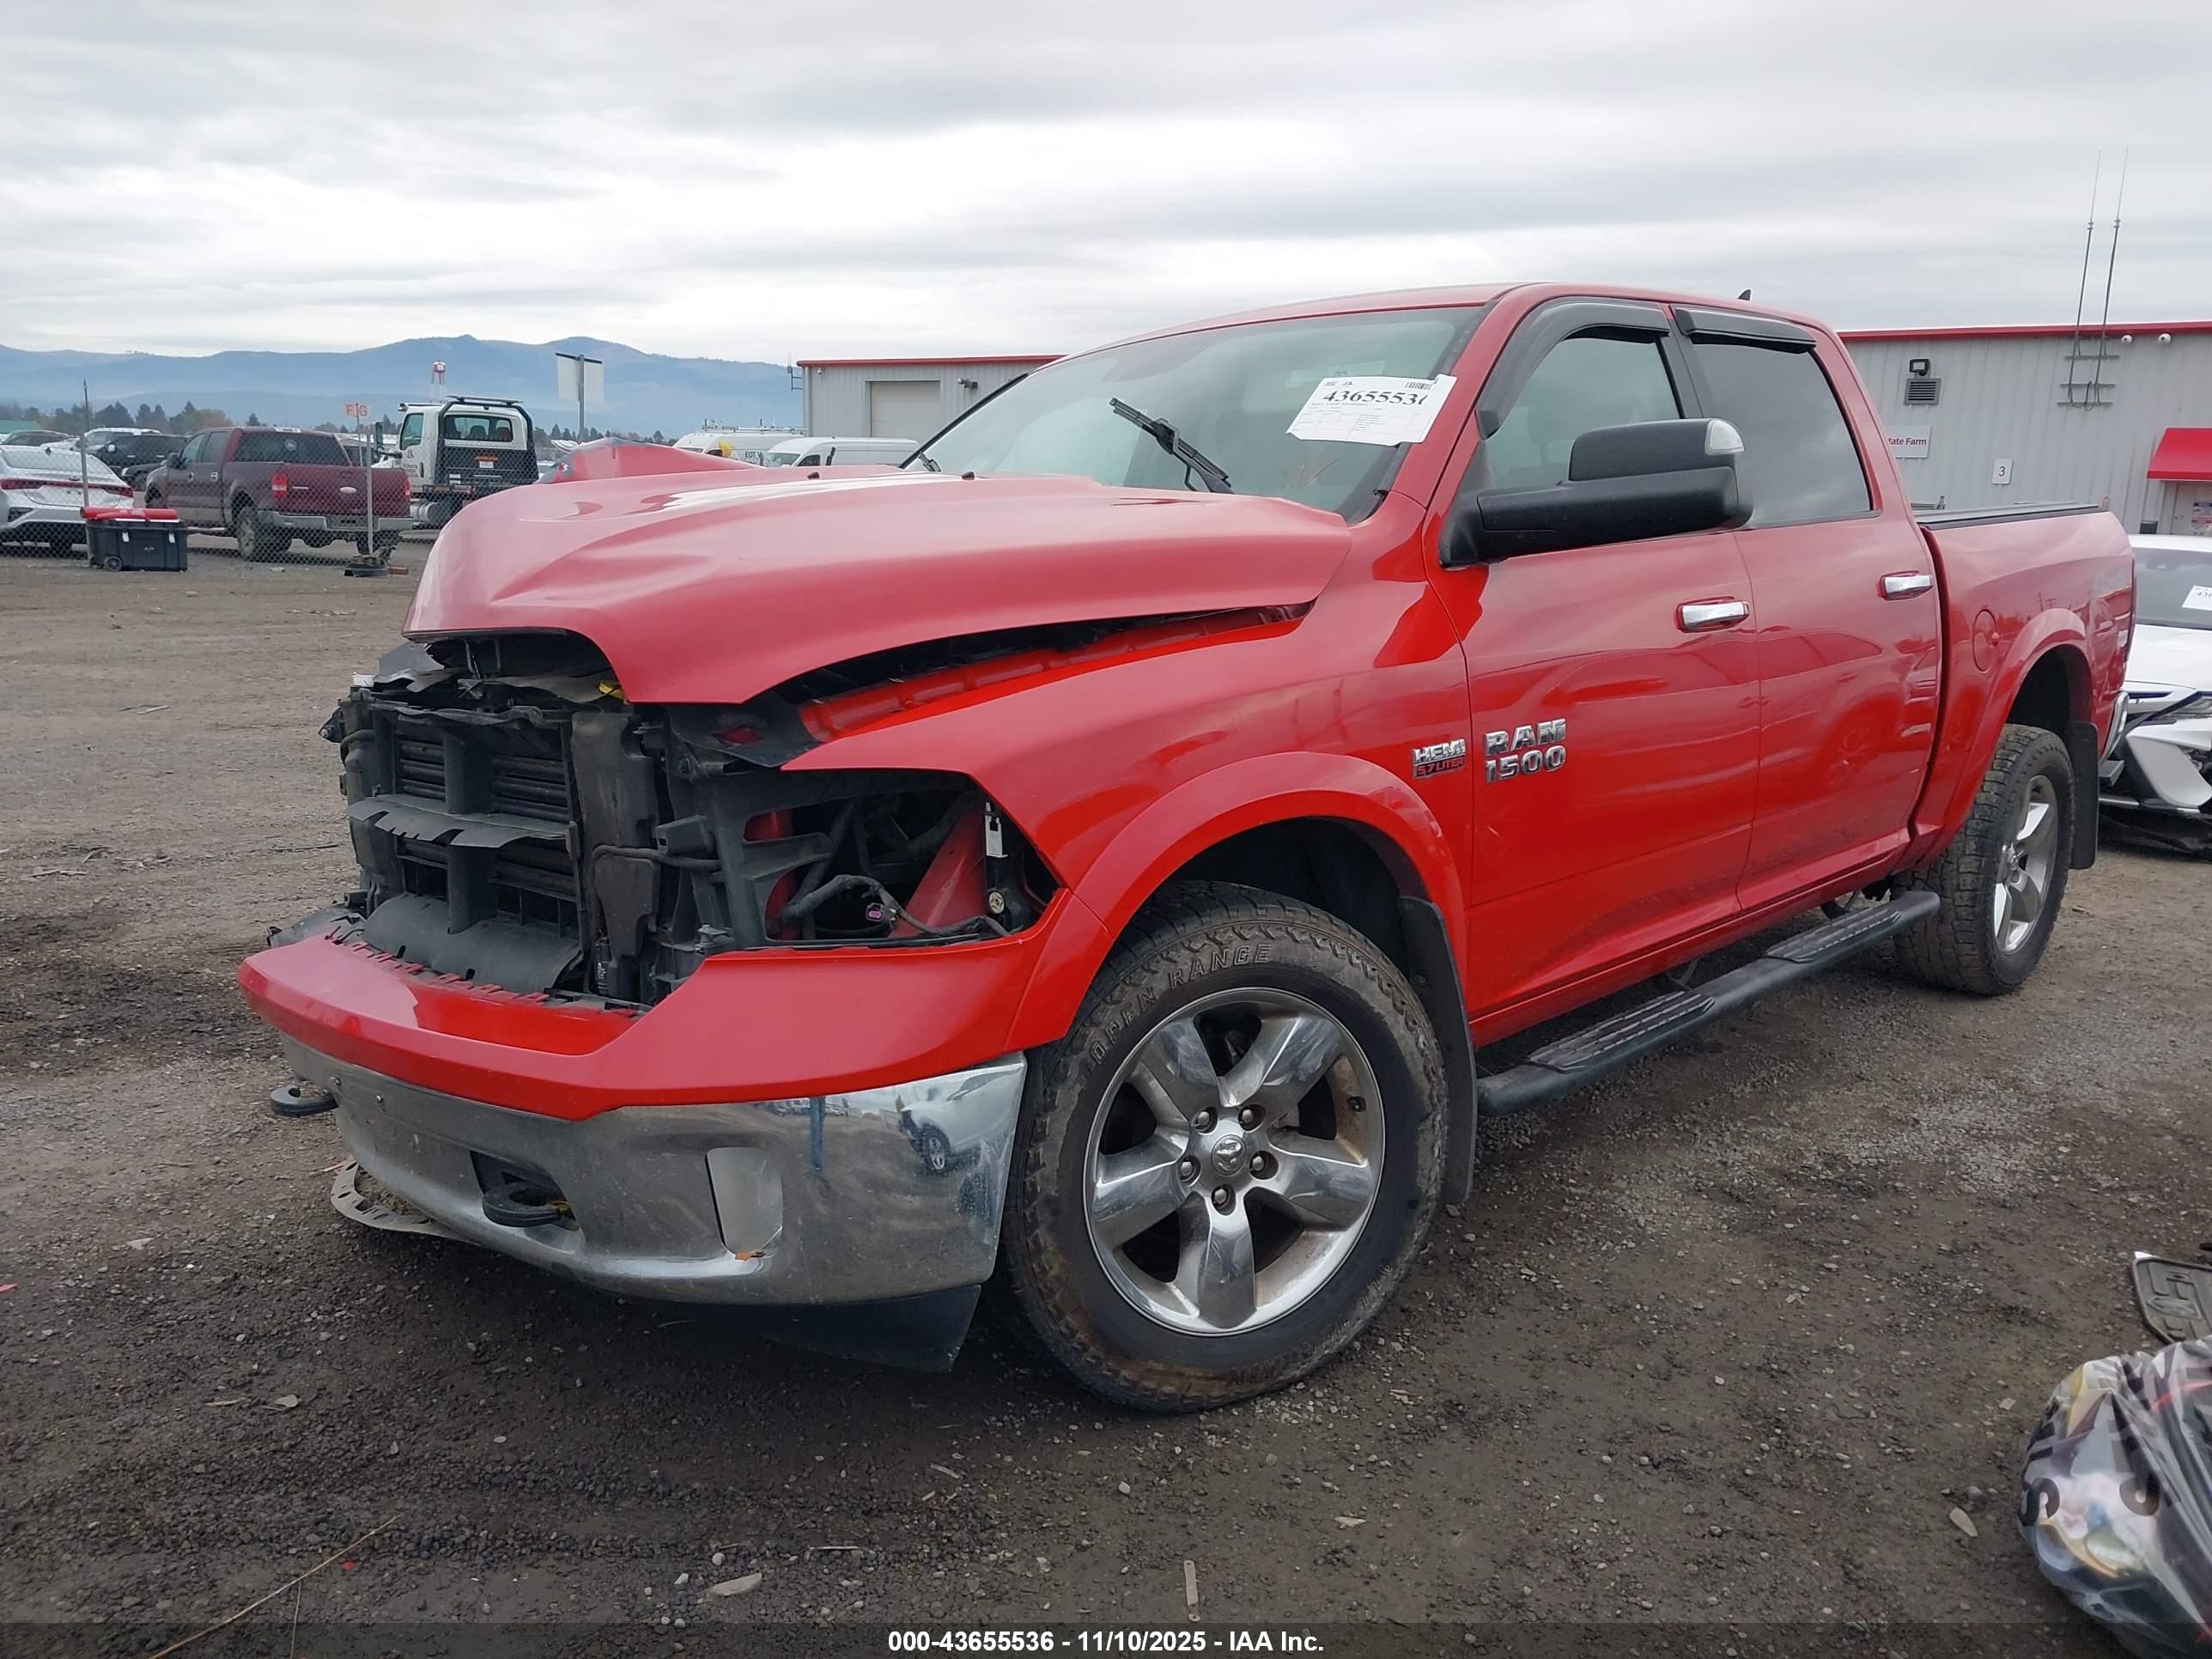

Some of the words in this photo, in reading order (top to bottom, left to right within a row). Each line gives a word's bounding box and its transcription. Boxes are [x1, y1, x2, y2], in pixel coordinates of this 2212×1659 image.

[1905, 437, 1927, 446] Farm
[1998, 465, 2006, 477] 3
[1484, 718, 1566, 757] RAM
[1412, 738, 1466, 763] HEMI
[1436, 756, 1465, 772] LITER
[1484, 744, 1566, 783] 1500
[1090, 988, 1157, 1065] OPEN
[1168, 944, 1272, 988] RANGE
